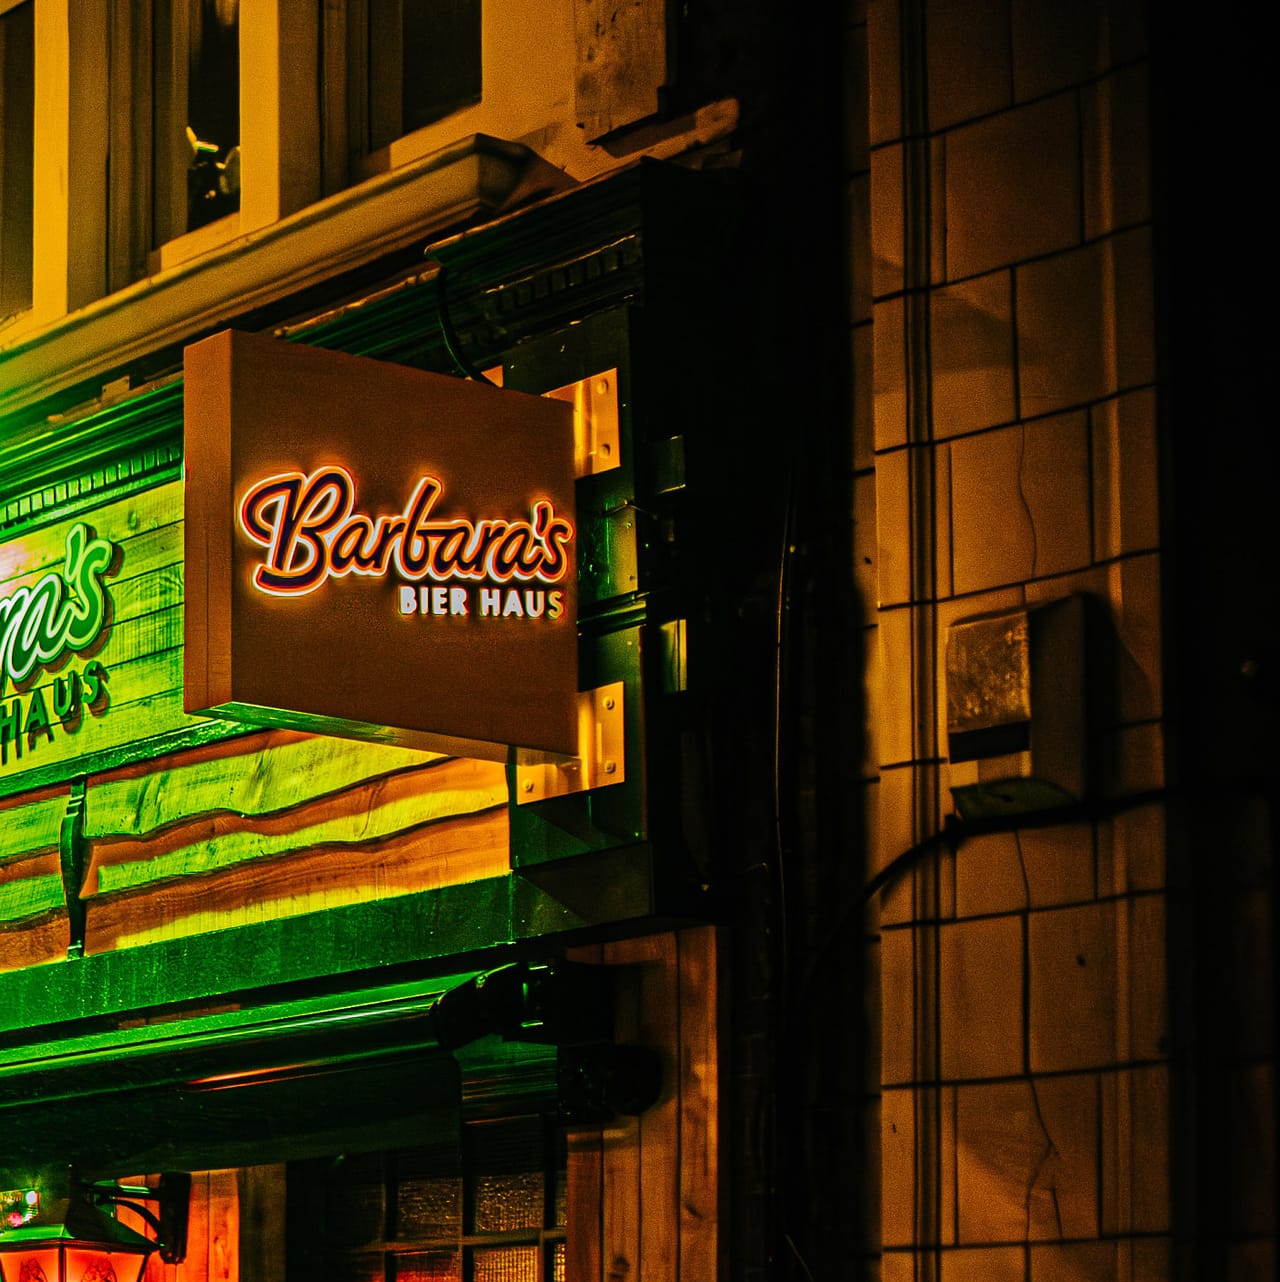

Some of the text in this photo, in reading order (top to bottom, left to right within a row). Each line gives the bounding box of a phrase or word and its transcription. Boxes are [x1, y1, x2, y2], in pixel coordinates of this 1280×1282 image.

[241, 465, 575, 597] Barbara's
[400, 586, 564, 619] BIER HAUS
